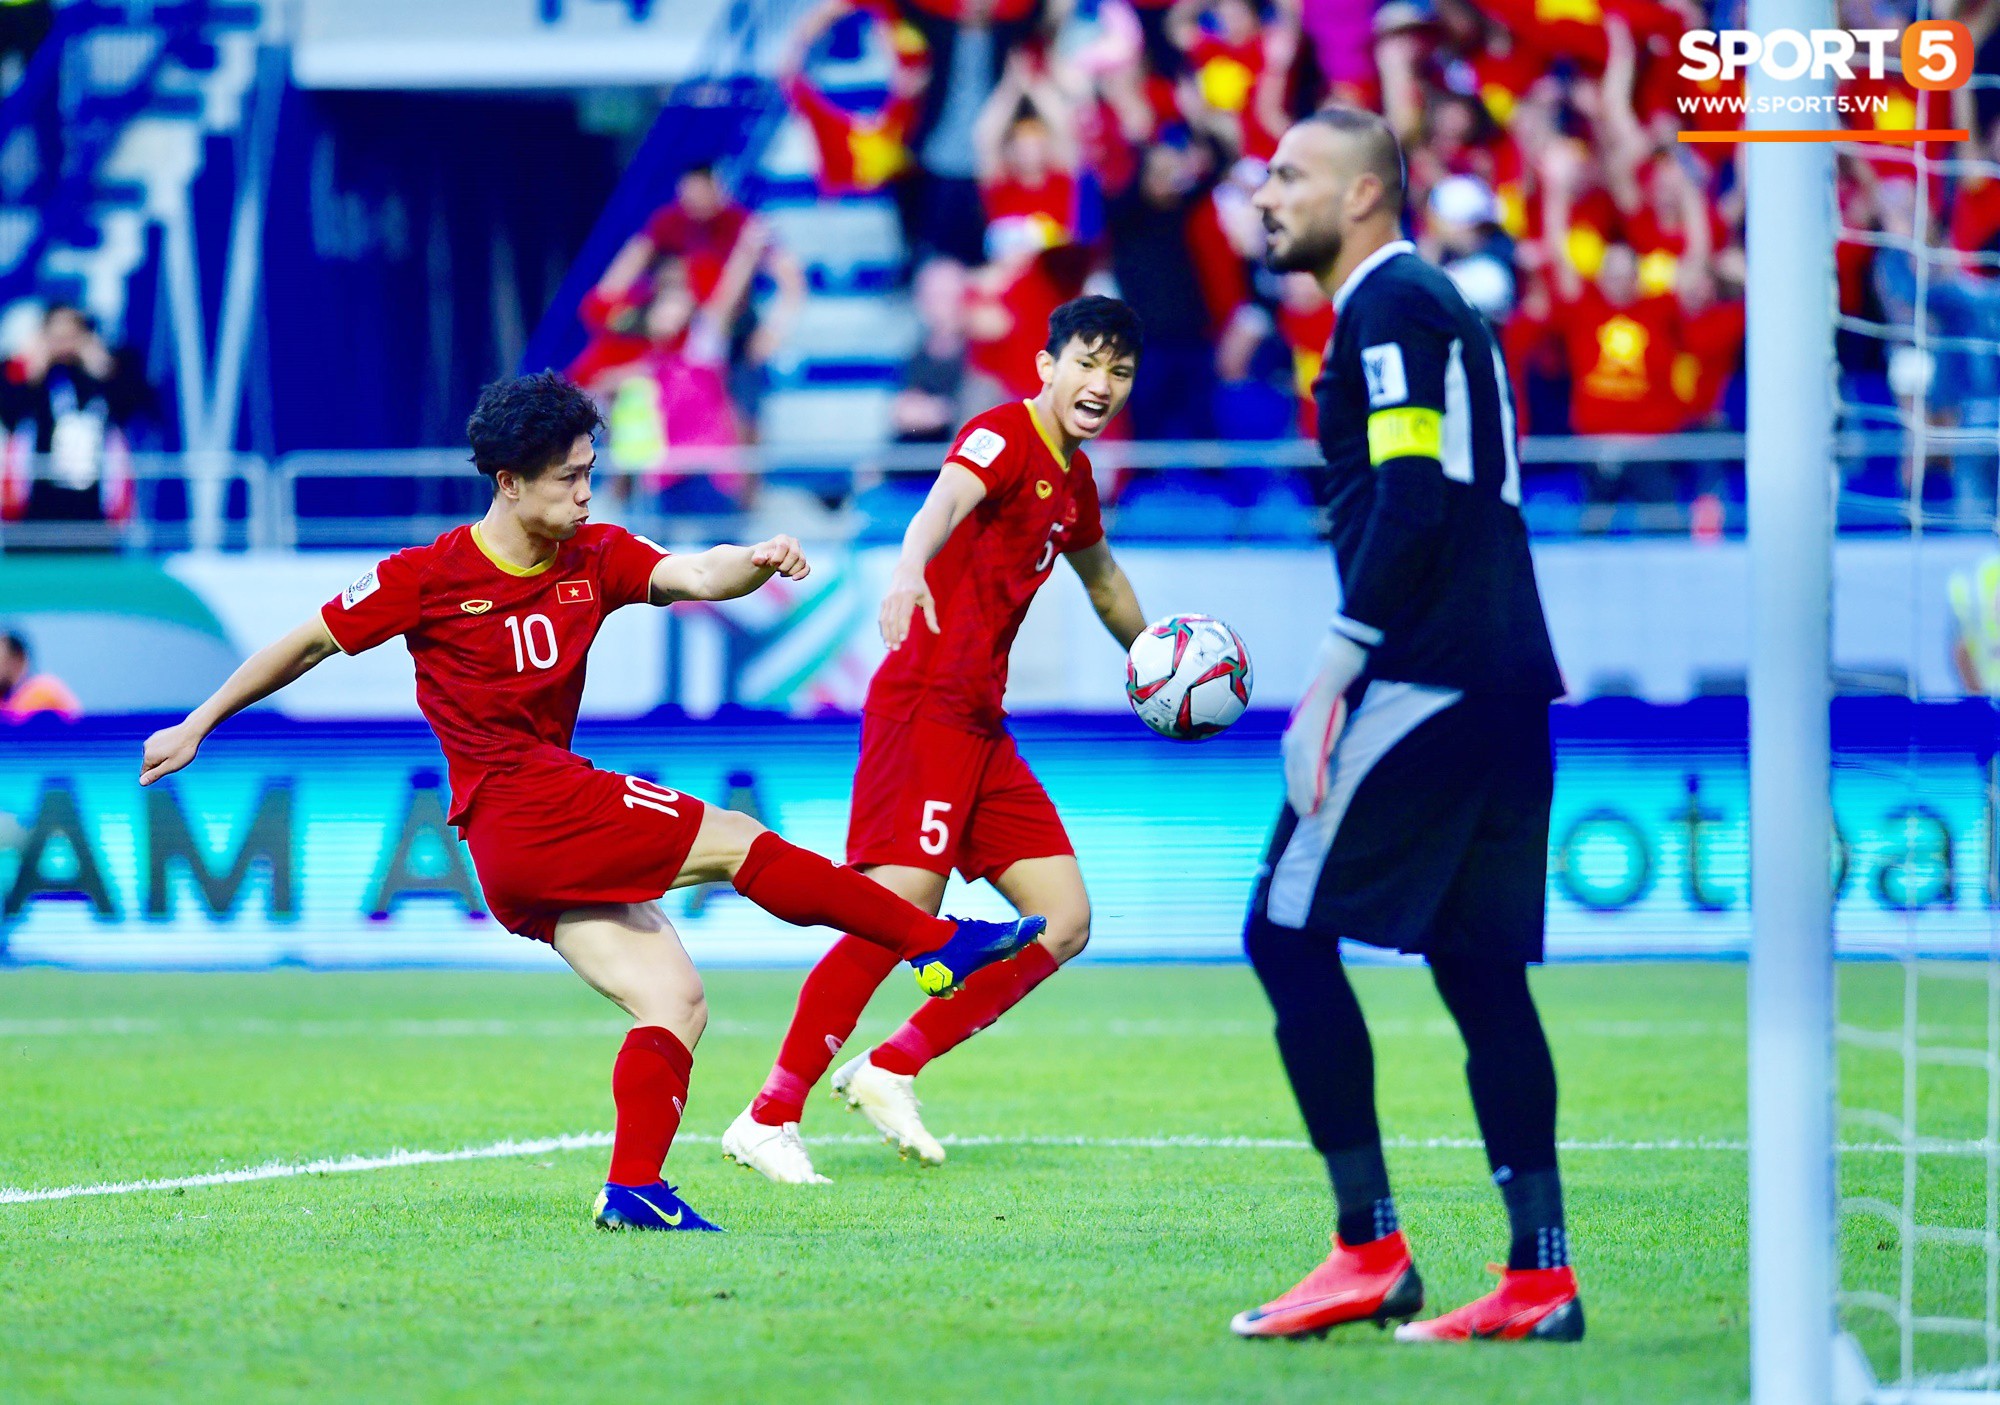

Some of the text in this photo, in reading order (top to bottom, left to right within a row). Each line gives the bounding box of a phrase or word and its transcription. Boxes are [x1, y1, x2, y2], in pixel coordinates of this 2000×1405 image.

[504, 613, 559, 673] 10
[622, 774, 680, 819] 10
[919, 799, 953, 856] 5
